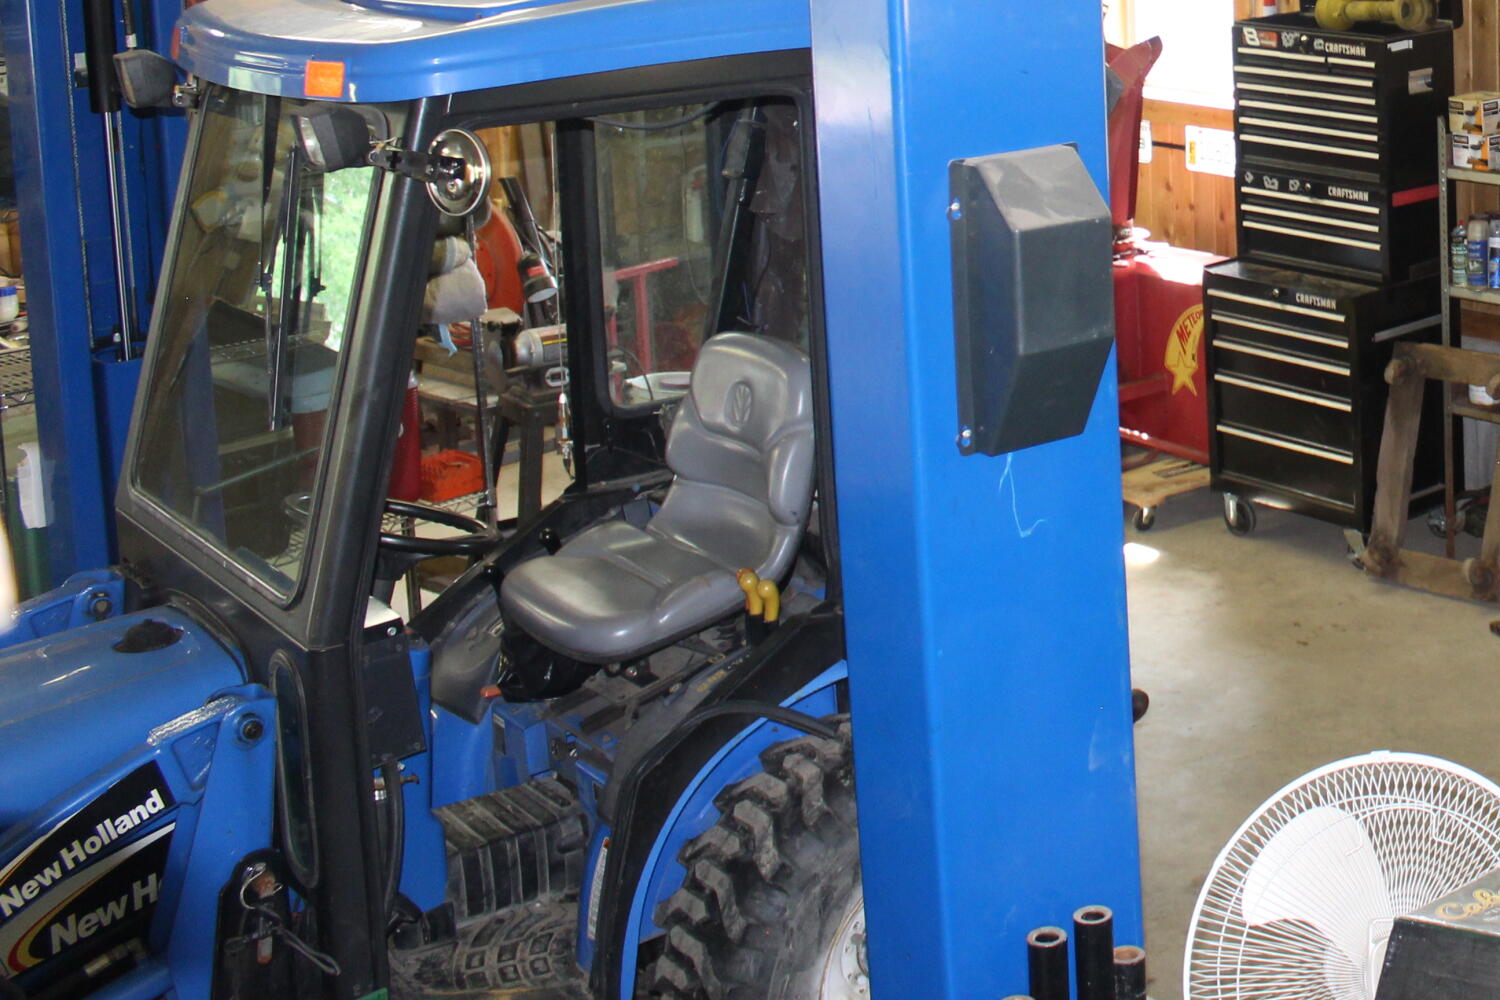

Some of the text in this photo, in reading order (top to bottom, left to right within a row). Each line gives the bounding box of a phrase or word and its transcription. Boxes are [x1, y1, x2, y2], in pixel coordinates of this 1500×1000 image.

[1324, 42, 1367, 57] CRAFTSMAN
[1327, 186, 1369, 202] CRAFTSMAN
[1295, 292, 1337, 310] CRAFTSMAN
[0, 789, 166, 917] New Holland
[49, 871, 162, 954] New H
